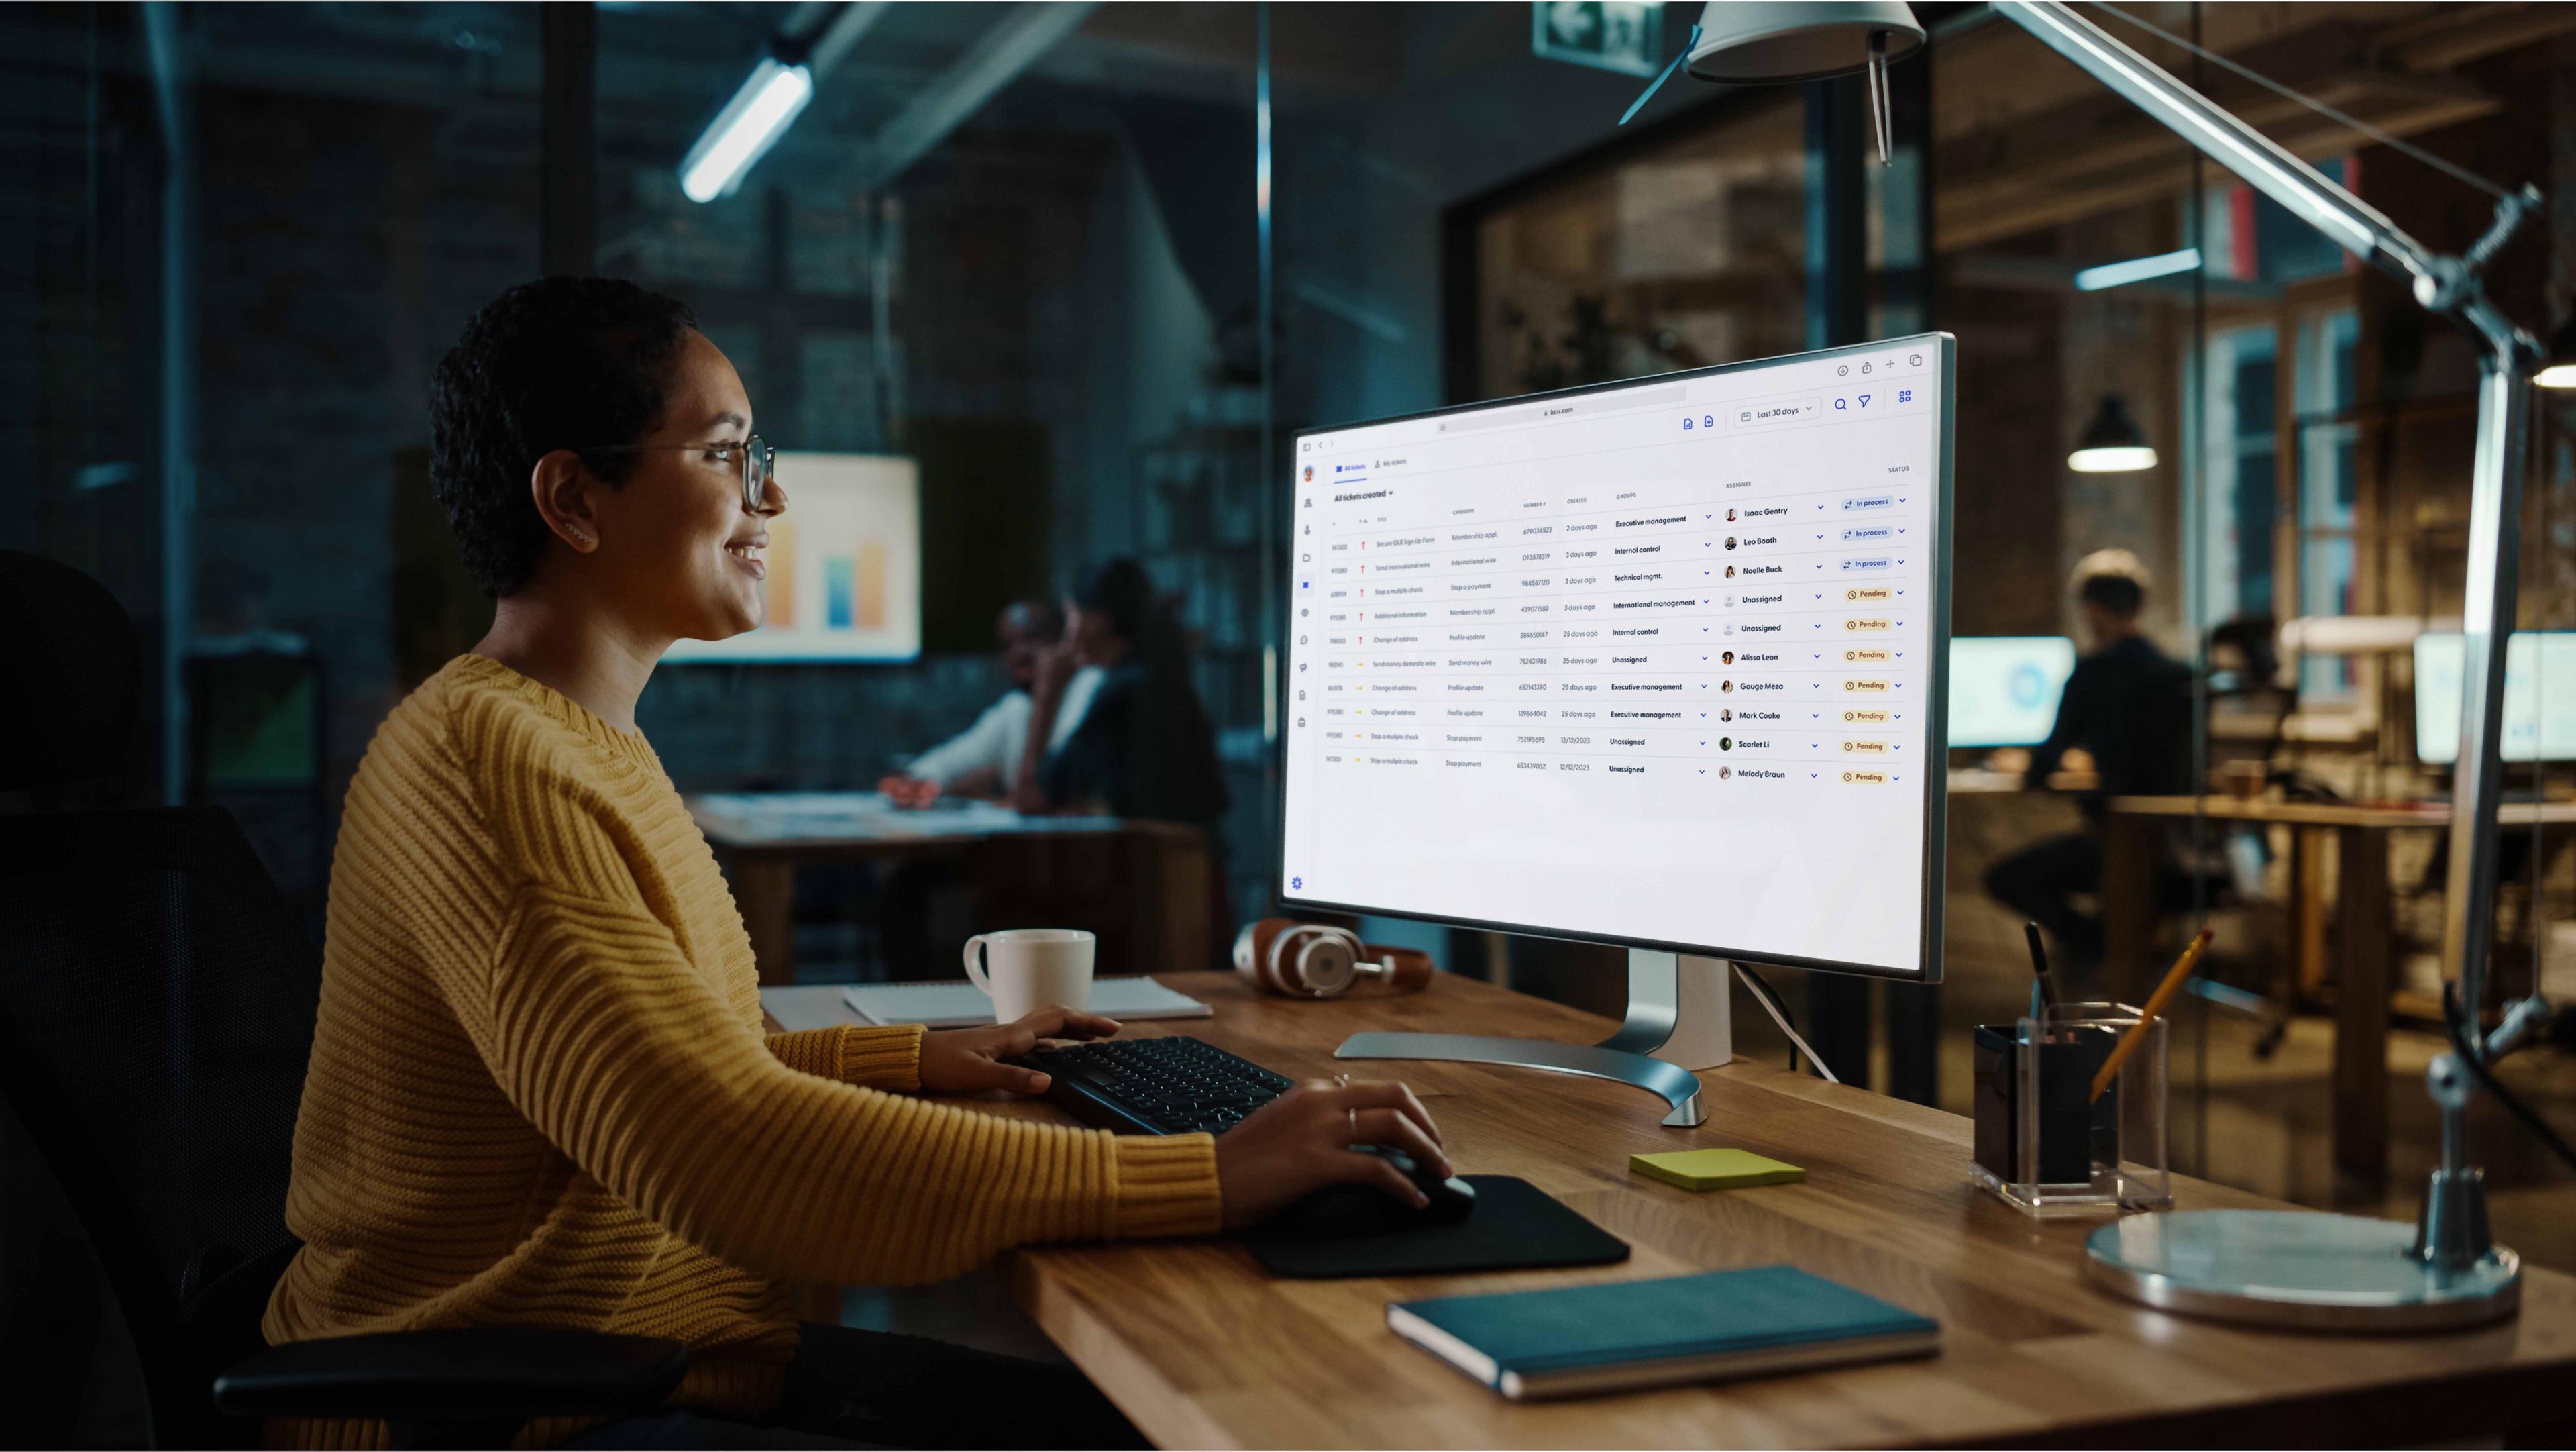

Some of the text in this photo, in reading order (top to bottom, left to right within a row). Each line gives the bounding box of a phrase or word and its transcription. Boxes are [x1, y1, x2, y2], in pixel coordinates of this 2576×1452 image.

[1550, 407, 1573, 415] bcu.com
[1772, 409, 1781, 417] 30
[1864, 499, 1888, 507] process
[1615, 516, 1686, 527] Executive management
[1523, 527, 1552, 535] 679034523
[1757, 537, 1777, 545] Booth
[1639, 545, 1660, 553] control
[1522, 553, 1550, 561] 093578319
[1451, 558, 1484, 566] International
[1615, 574, 1642, 582] Technical
[1742, 594, 1782, 604] Unassigned
[1613, 600, 1695, 609] International management
[1741, 624, 1781, 633] Unassigned
[1612, 656, 1647, 664] Unassigned
[1740, 683, 1764, 691] Gauge
[1858, 682, 1884, 690] Pending
[1858, 713, 1884, 721] Pending
[1610, 738, 1645, 747] Unassigned
[1857, 743, 1883, 751] Pending
[1609, 766, 1644, 774] Unassigned
[1738, 770, 1764, 778] Melody
[1856, 774, 1882, 782] Pending
